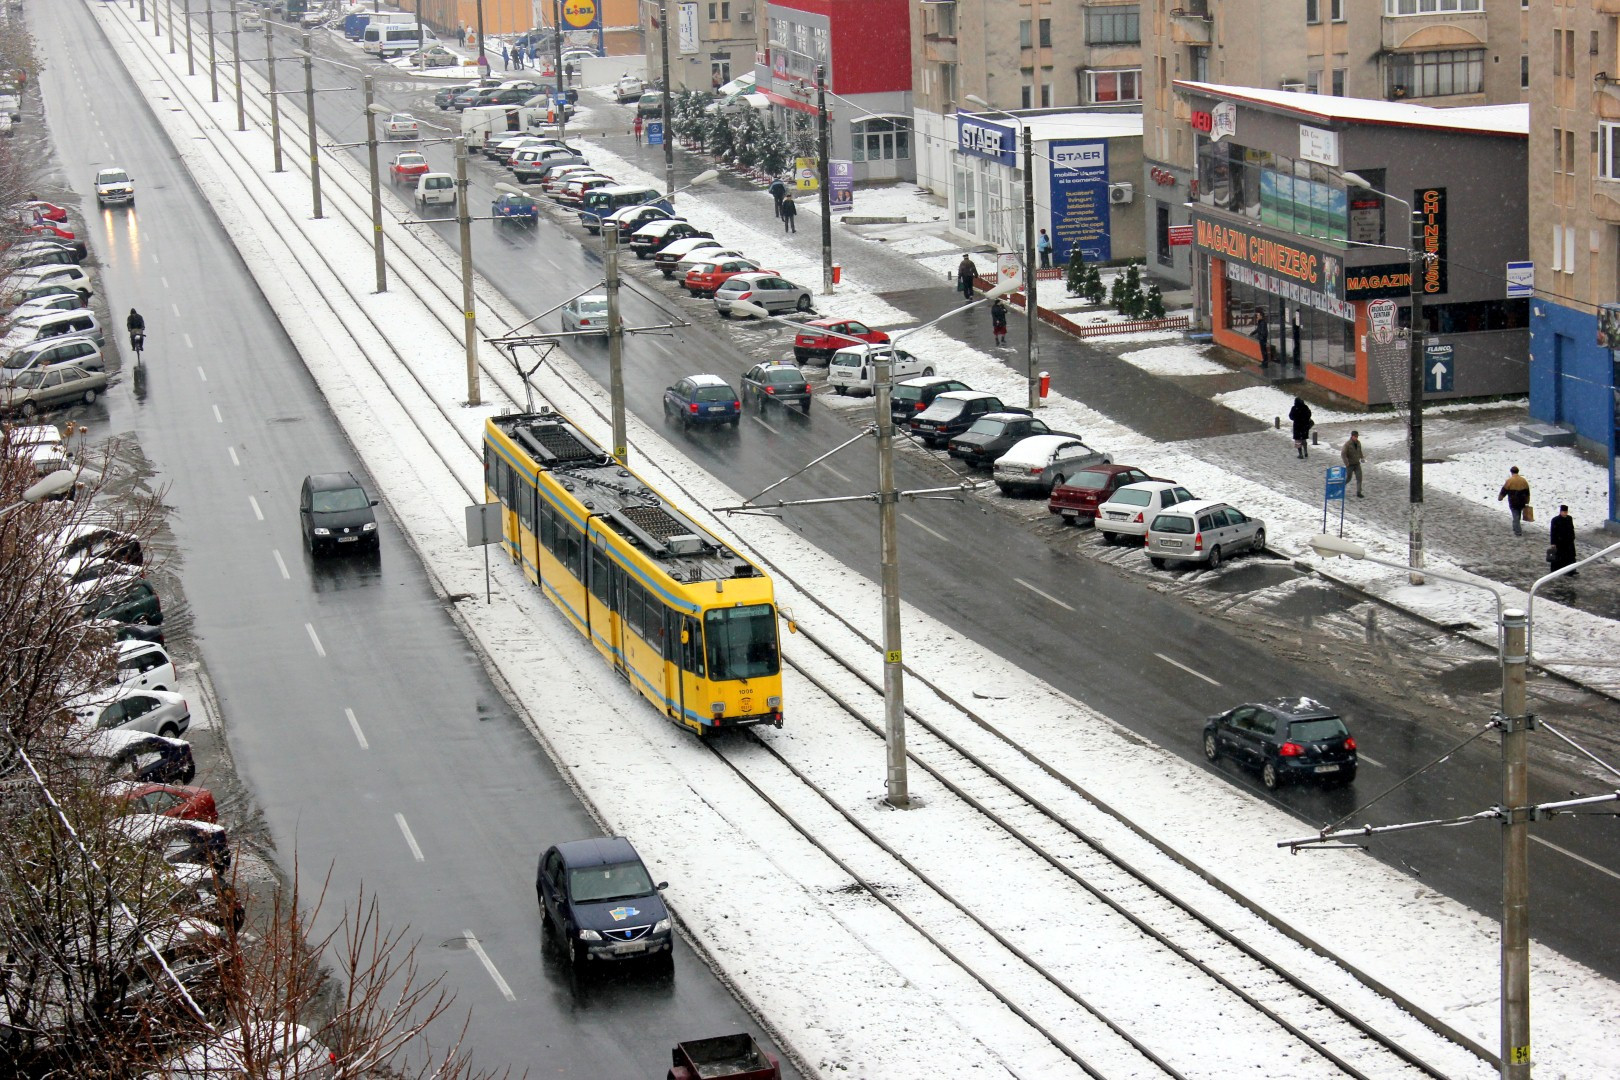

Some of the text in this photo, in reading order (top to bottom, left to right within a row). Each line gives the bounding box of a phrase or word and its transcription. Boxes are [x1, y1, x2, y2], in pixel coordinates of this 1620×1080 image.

[962, 123, 1002, 157] STAER
[1057, 151, 1101, 161] STAER
[1197, 219, 1317, 283] MAGAZIN CHINEZESC
[1347, 274, 1412, 290] MAGAZIN
[1516, 1047, 1527, 1059] 54
